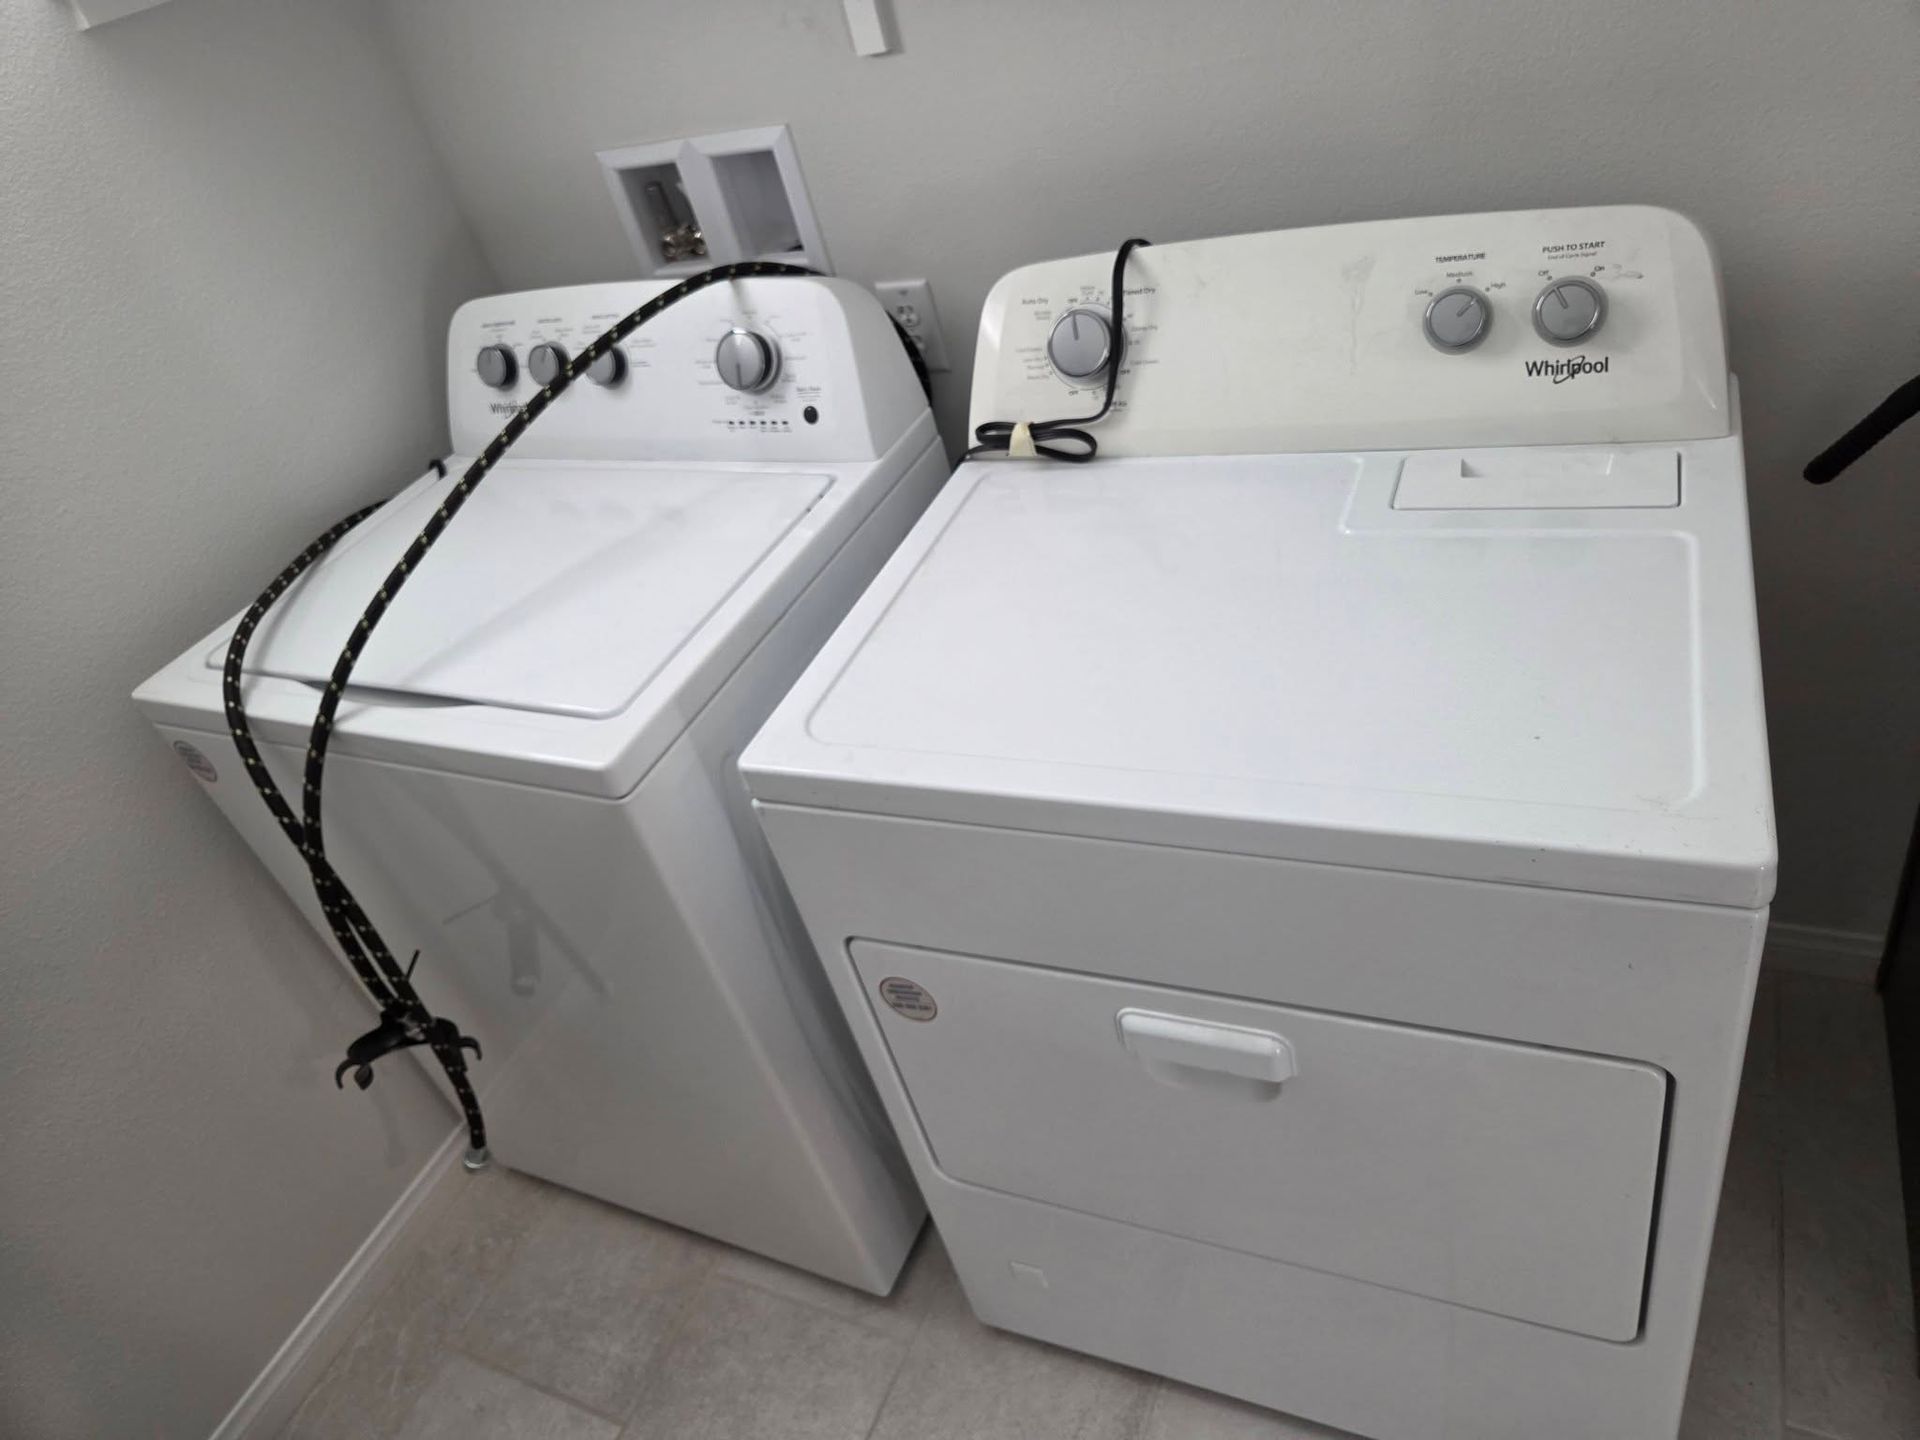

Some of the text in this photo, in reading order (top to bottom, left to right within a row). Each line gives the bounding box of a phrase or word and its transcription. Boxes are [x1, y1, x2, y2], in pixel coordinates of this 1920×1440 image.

[1542, 245, 1564, 253] PUSH
[1579, 241, 1605, 250] START
[1435, 252, 1485, 263] TEMPERATURE
[1525, 355, 1609, 384] Whirlpool
